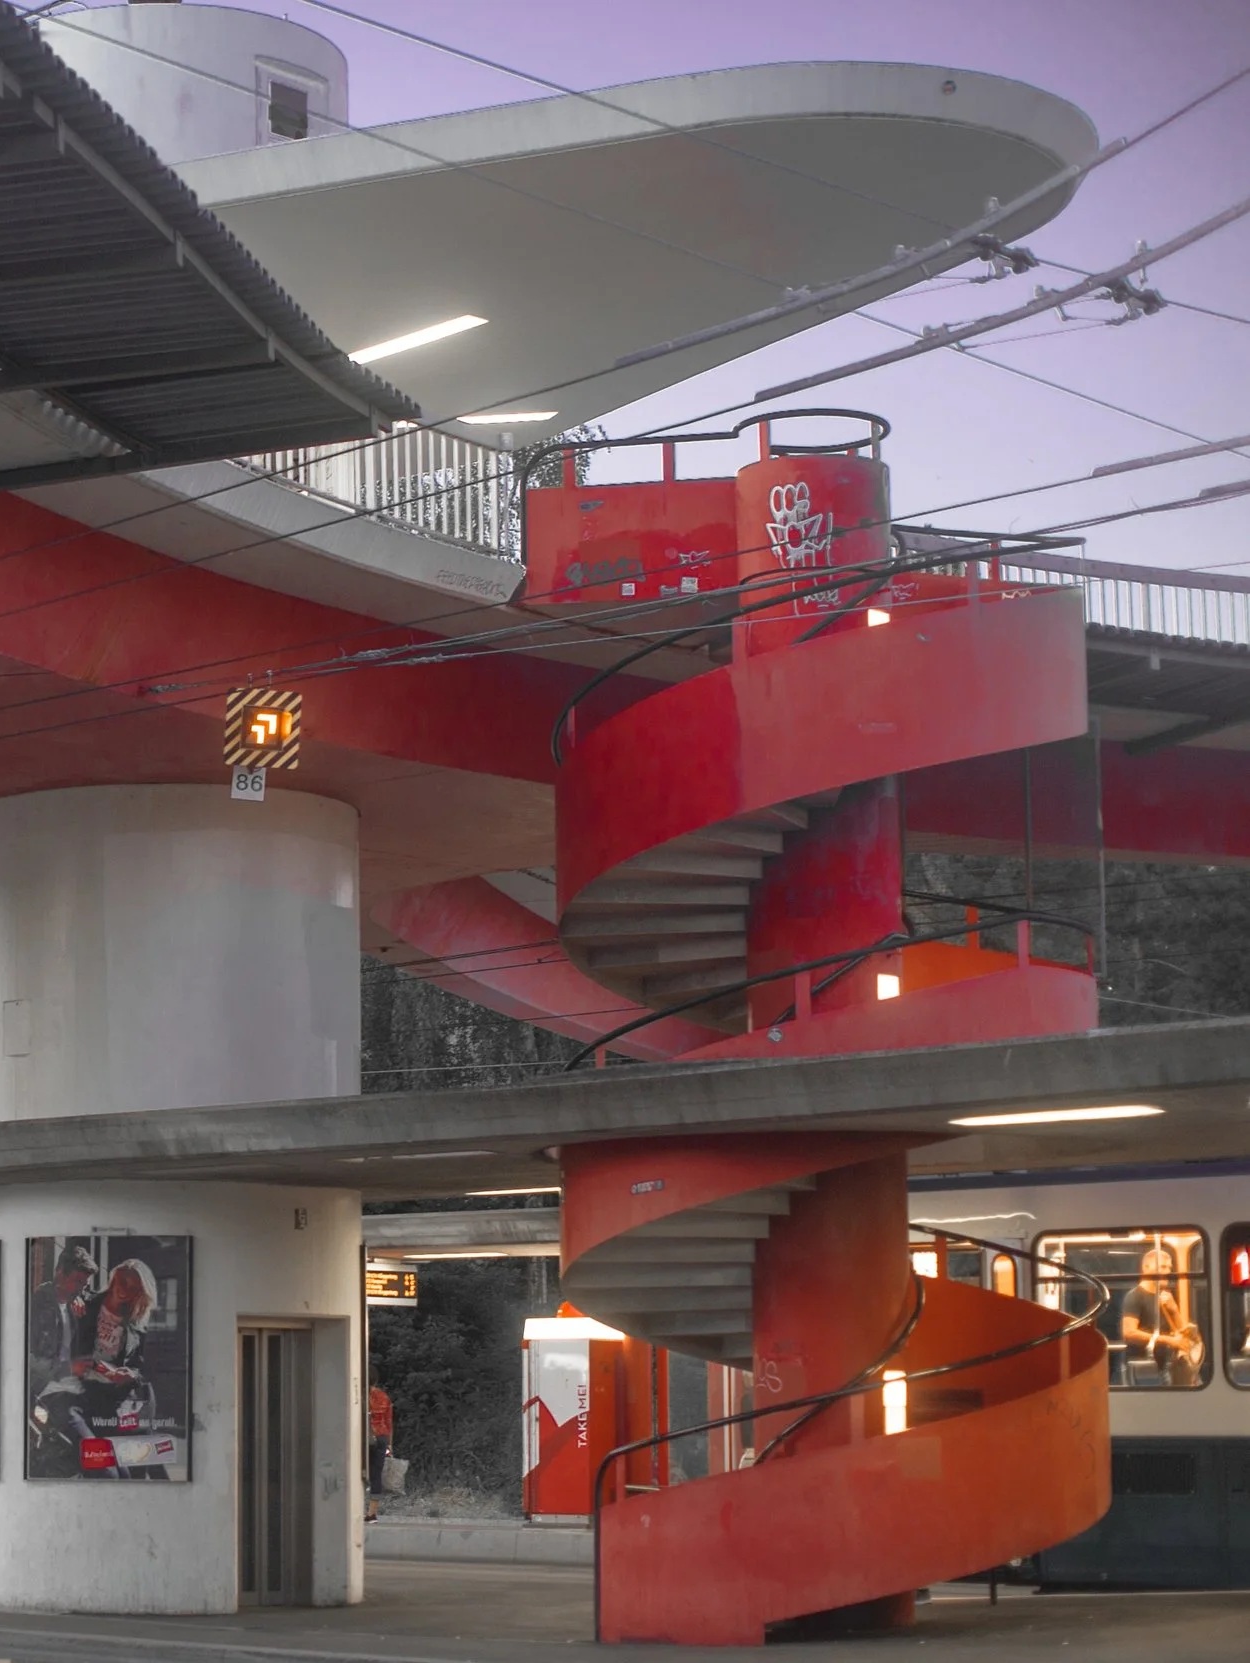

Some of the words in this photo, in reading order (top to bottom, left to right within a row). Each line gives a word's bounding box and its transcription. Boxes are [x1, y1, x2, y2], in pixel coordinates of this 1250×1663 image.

[236, 773, 263, 792] 86
[578, 1385, 587, 1409] ME!
[578, 1412, 587, 1448] TAKE
